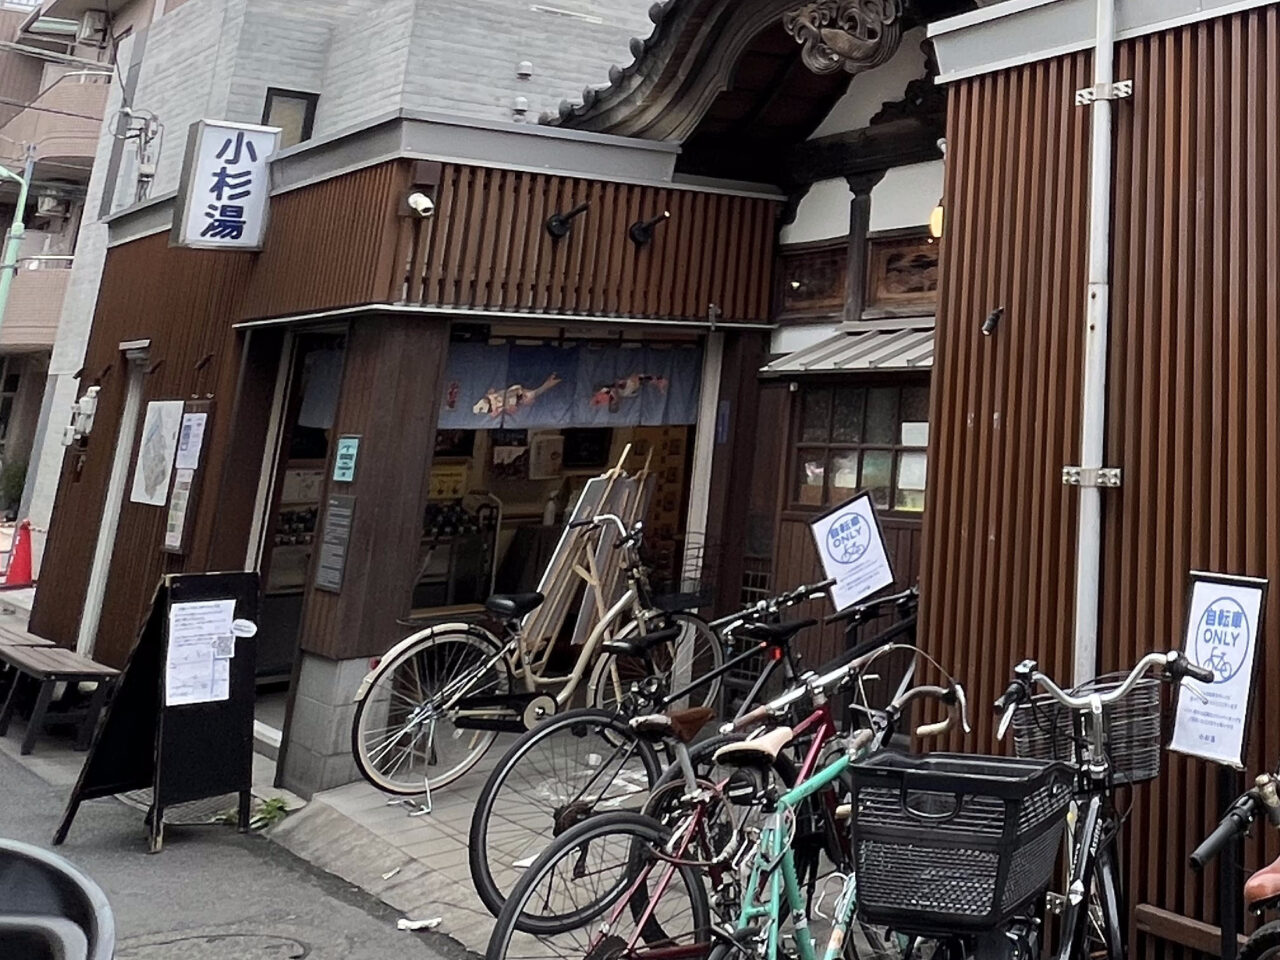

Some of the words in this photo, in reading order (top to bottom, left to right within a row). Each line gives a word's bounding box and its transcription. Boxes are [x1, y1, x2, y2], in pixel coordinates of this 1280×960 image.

[201, 131, 257, 239] 小杉湯
[830, 515, 860, 539] 自転車
[833, 525, 862, 548] ONLY
[1205, 608, 1243, 629] 自転車
[1203, 628, 1240, 647] ONLY
